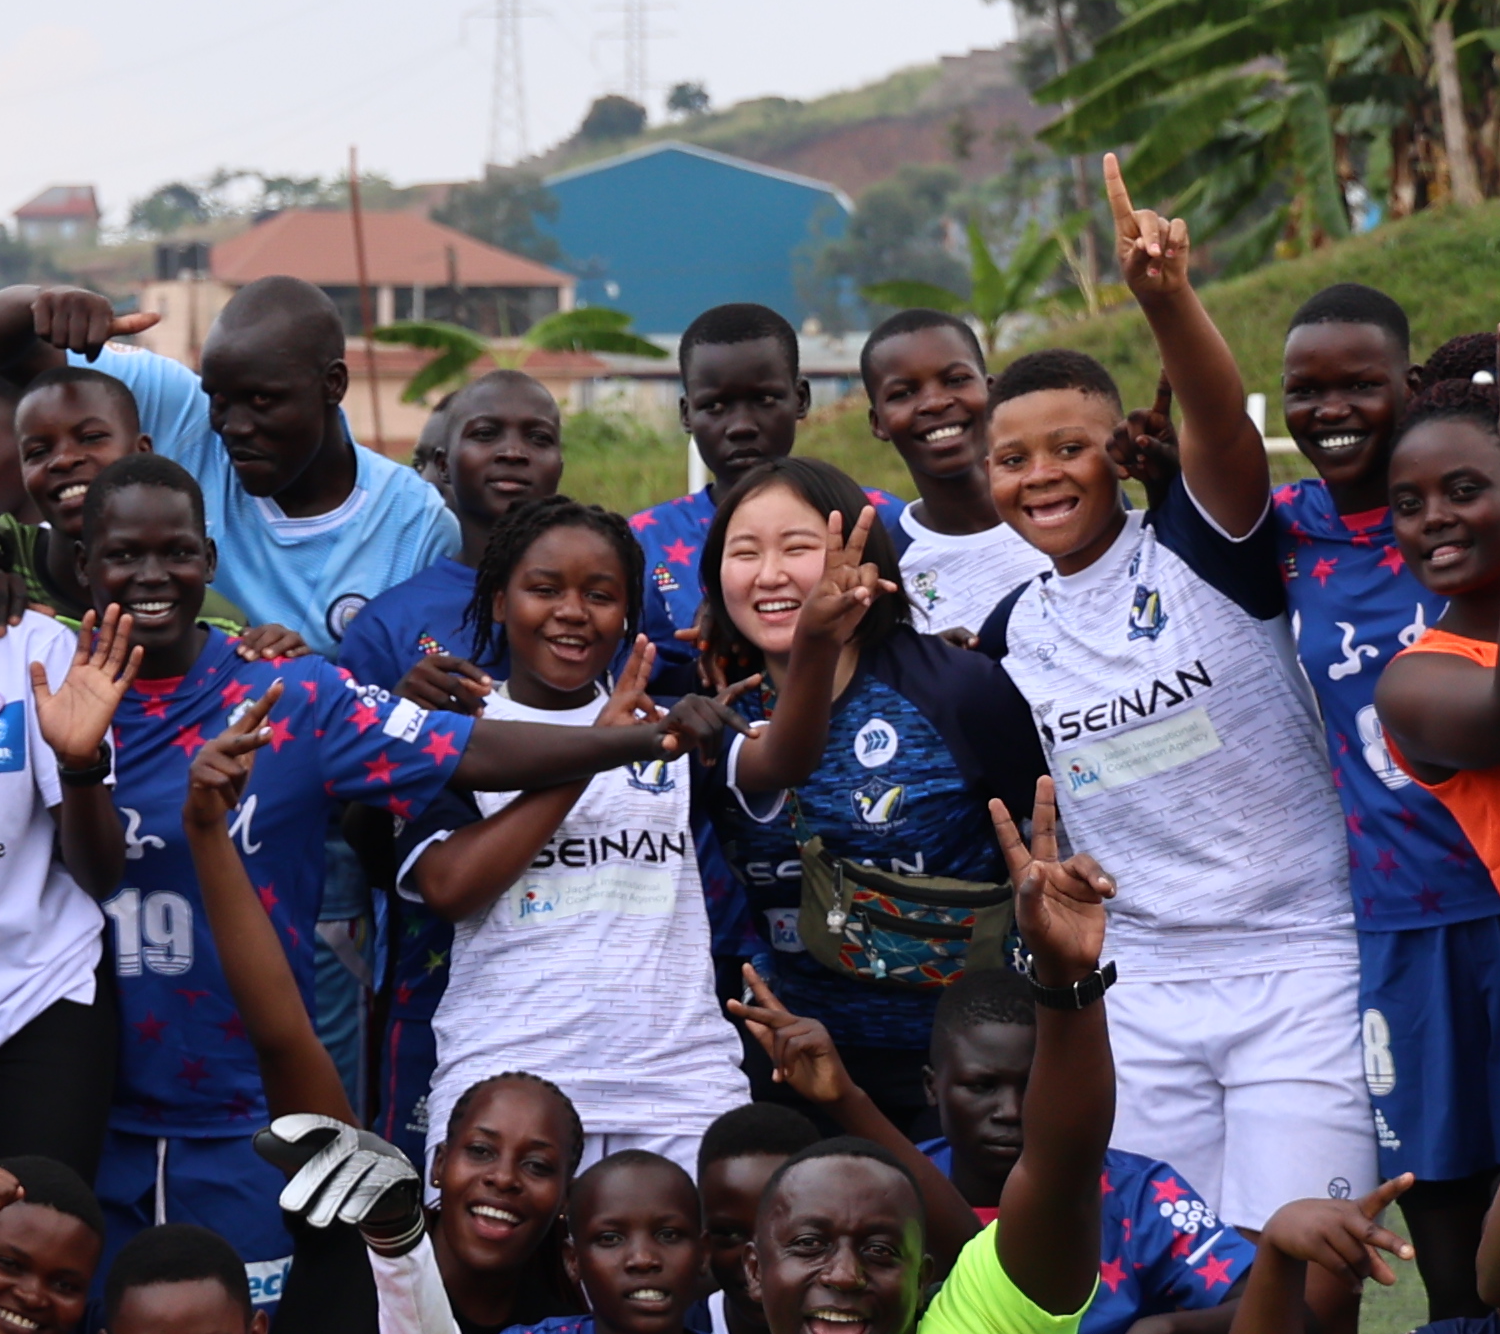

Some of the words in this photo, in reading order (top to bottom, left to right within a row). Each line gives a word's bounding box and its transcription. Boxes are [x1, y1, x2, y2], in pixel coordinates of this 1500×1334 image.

[1058, 659, 1213, 742] SEINAN
[1069, 764, 1100, 792] JICA
[531, 829, 685, 869] SEINAN
[101, 887, 194, 978] 19
[518, 895, 554, 918] JICA
[1362, 1007, 1397, 1097] 8
